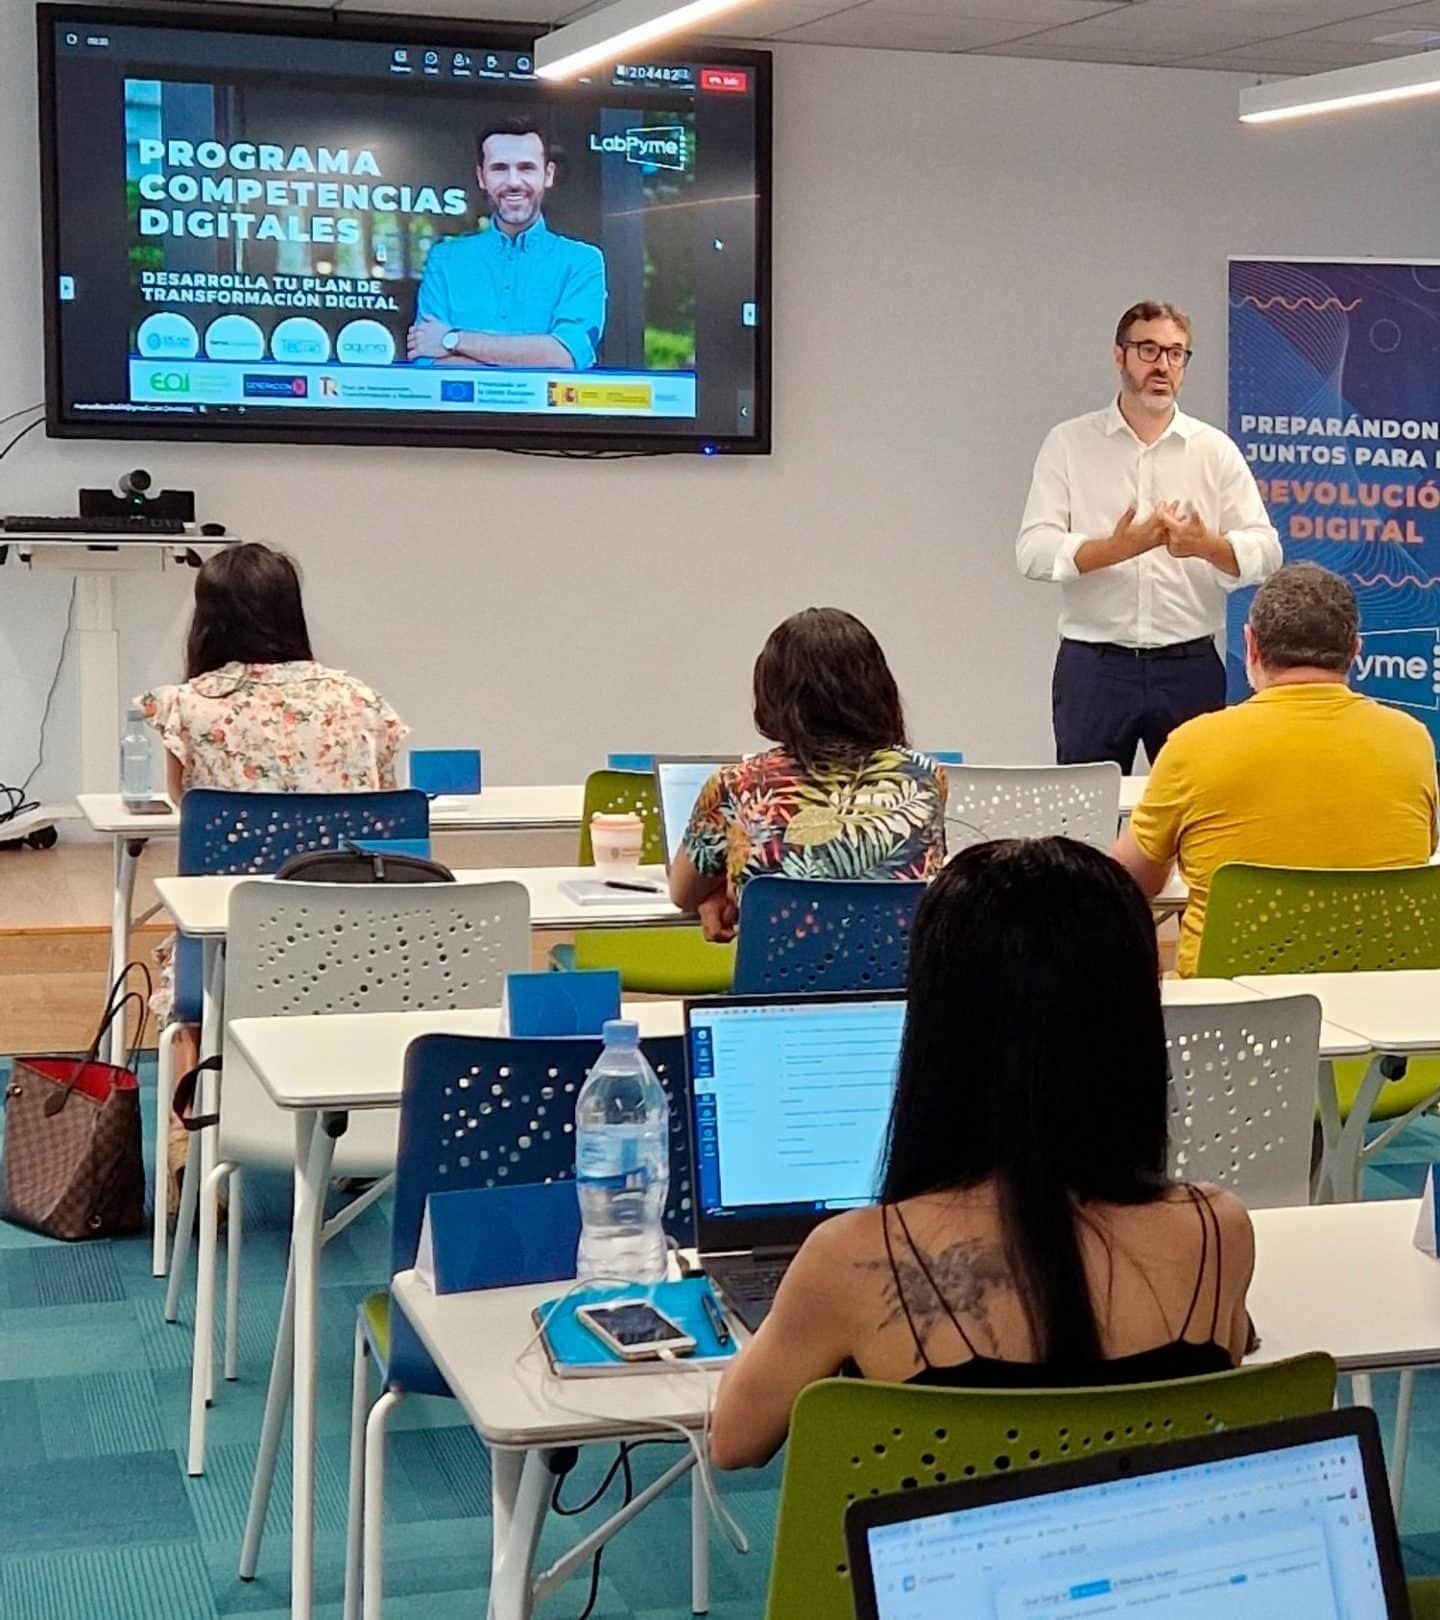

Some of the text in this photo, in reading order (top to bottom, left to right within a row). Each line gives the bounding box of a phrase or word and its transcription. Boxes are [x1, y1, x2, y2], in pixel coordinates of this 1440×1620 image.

[138, 138, 382, 178] PROGRAMA
[590, 133, 678, 156] LabPyme
[138, 174, 467, 216] COMPETENCIAS
[138, 208, 361, 245] DIGITALES
[142, 271, 382, 295] DESARROLLA TU PLAN DE
[142, 286, 399, 311] TRANSFORMACIÓN DIGITAL
[1245, 442, 1346, 466] JUNTOS
[1355, 447, 1427, 468] PARA
[1289, 515, 1424, 544] DIGITAL
[1354, 654, 1429, 681] yme
